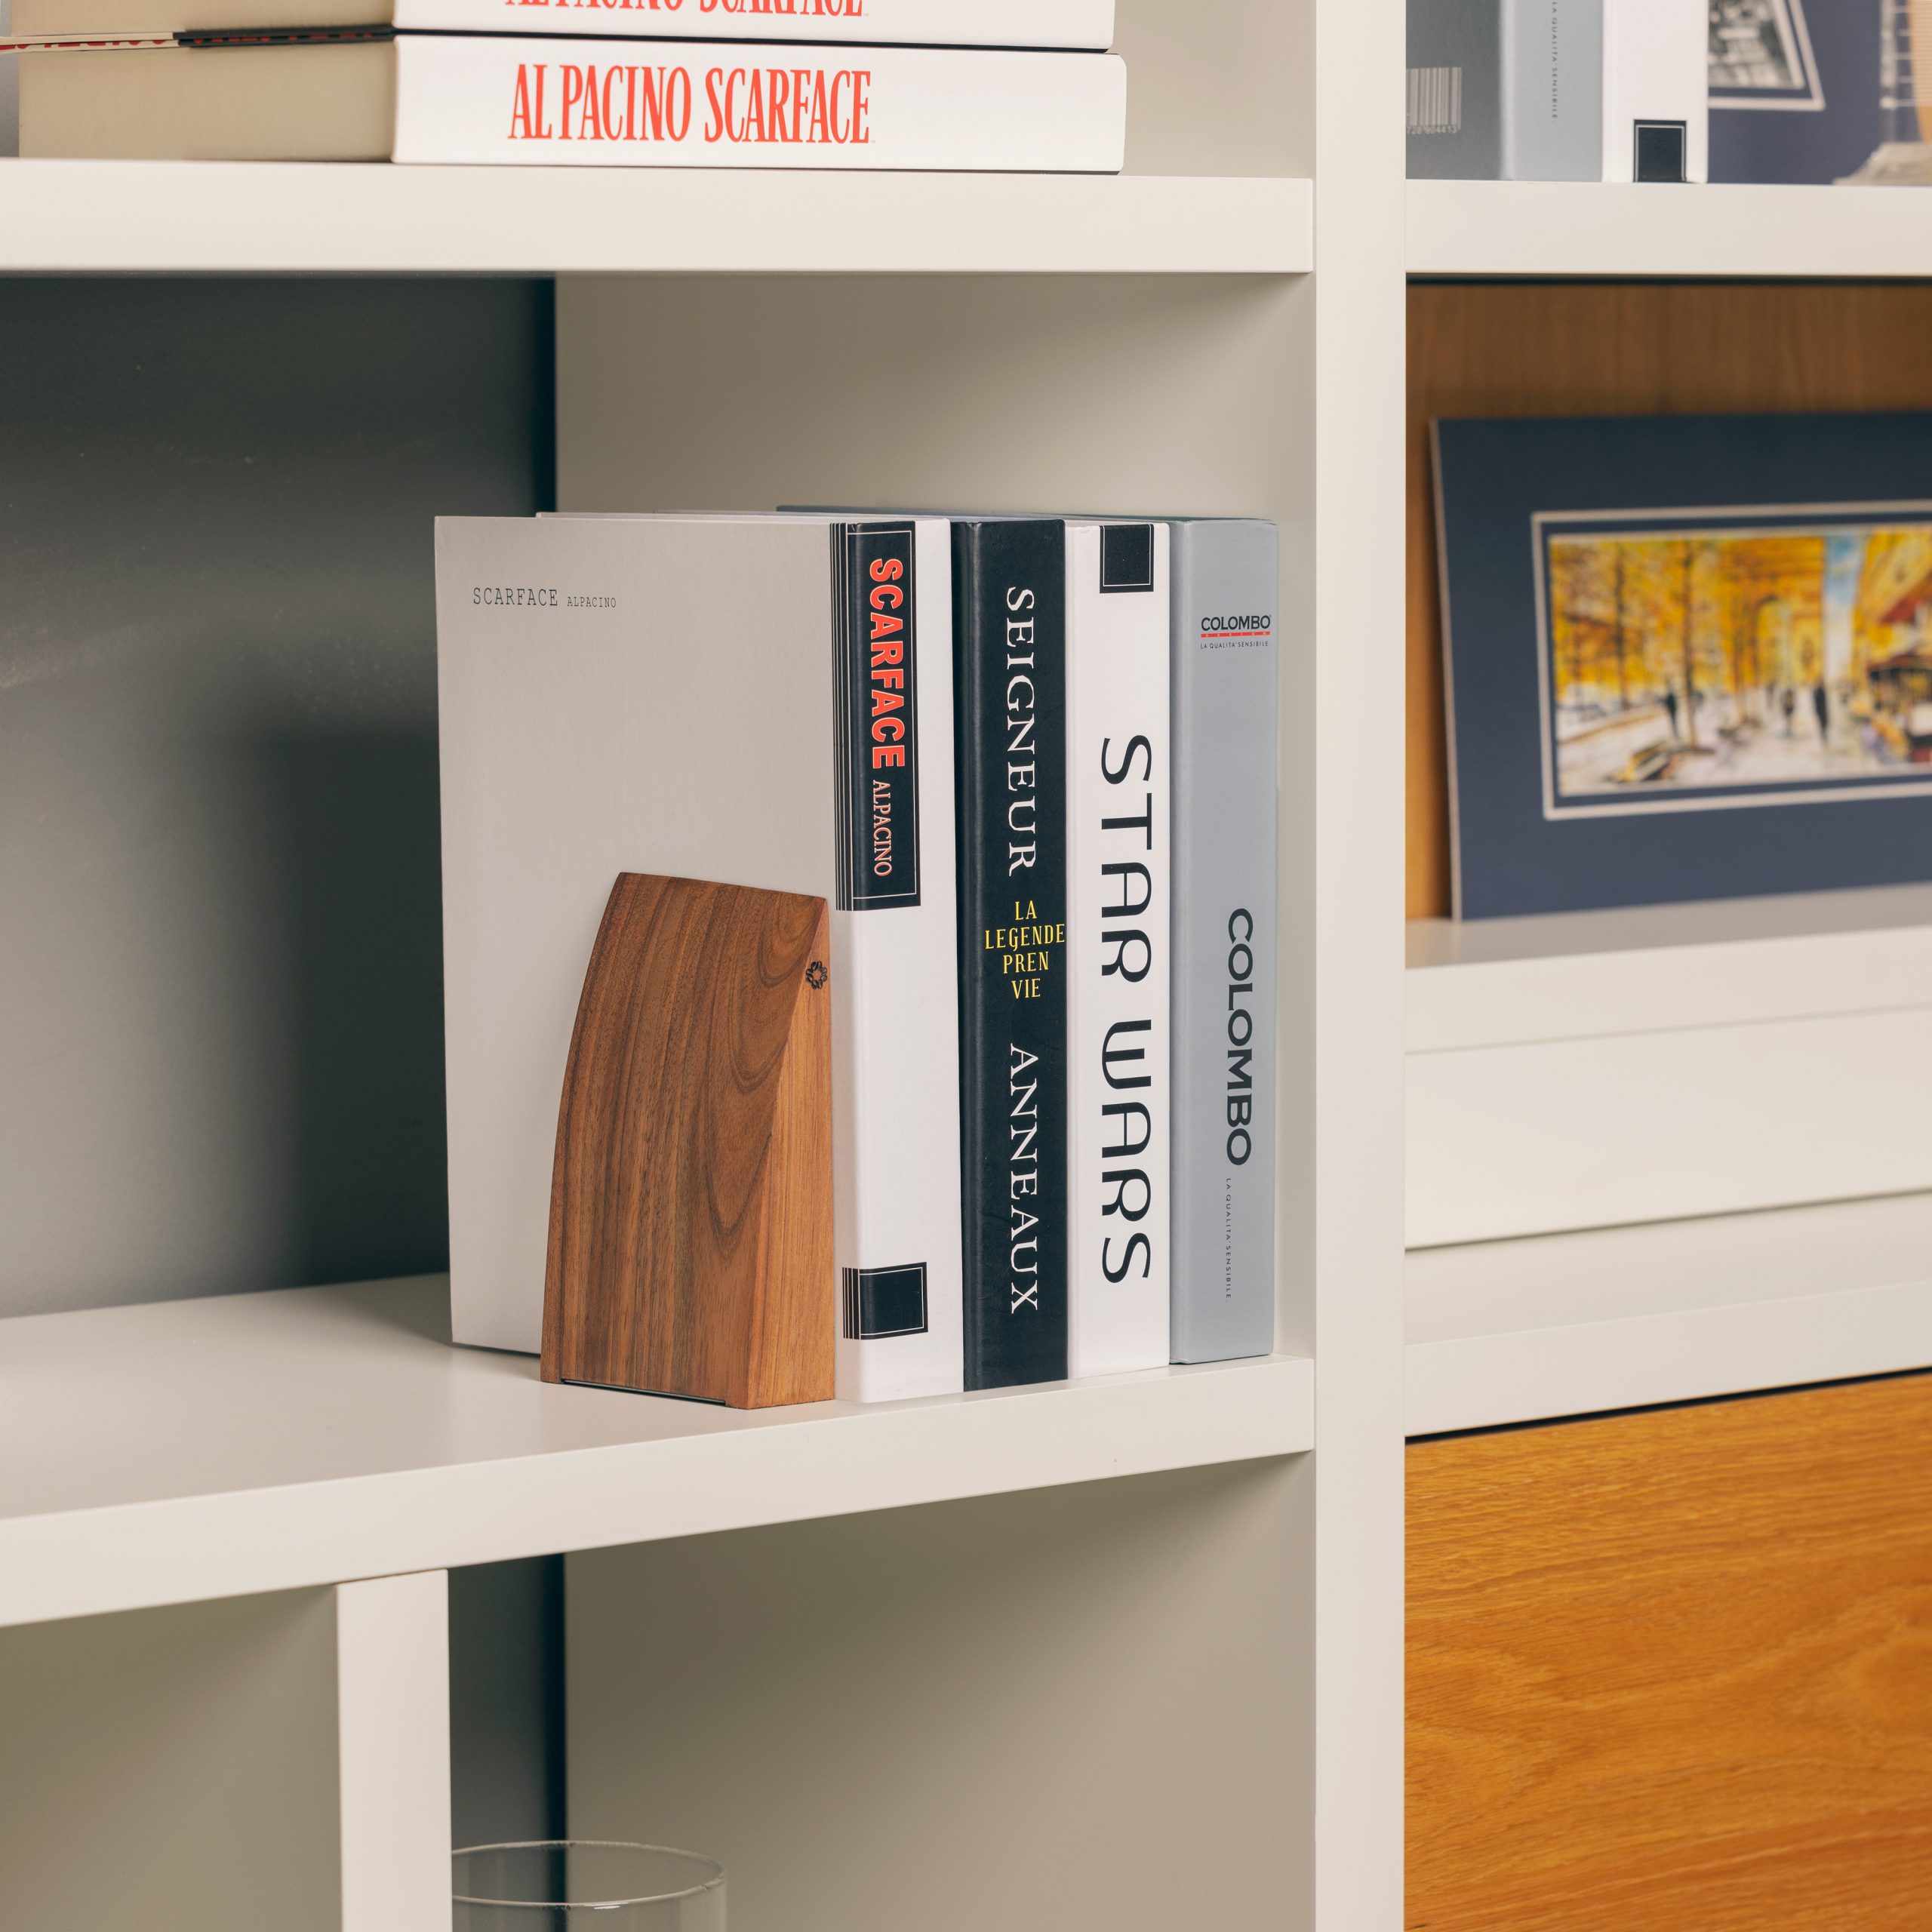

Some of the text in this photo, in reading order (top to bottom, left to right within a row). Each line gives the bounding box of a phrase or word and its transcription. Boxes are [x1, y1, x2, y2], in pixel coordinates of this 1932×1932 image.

[508, 63, 871, 144] AL PACINO SCARFACE
[473, 586, 617, 608] SCARFACE ALPACINO
[1201, 615, 1271, 631] COLOMBO
[869, 558, 906, 877] SCARFACE ALPACINO
[1006, 586, 1036, 877] SEIGNEUR
[1014, 900, 1038, 921] LA
[985, 923, 1066, 952] LEGENDE
[1003, 949, 1049, 974] PREN
[1011, 977, 1041, 999] VIE
[1100, 734, 1152, 1284] STAR WARS
[1226, 908, 1254, 1166] COLOMBO
[1010, 1042, 1039, 1315] ANNEAUX
[1226, 1177, 1232, 1190] LA
